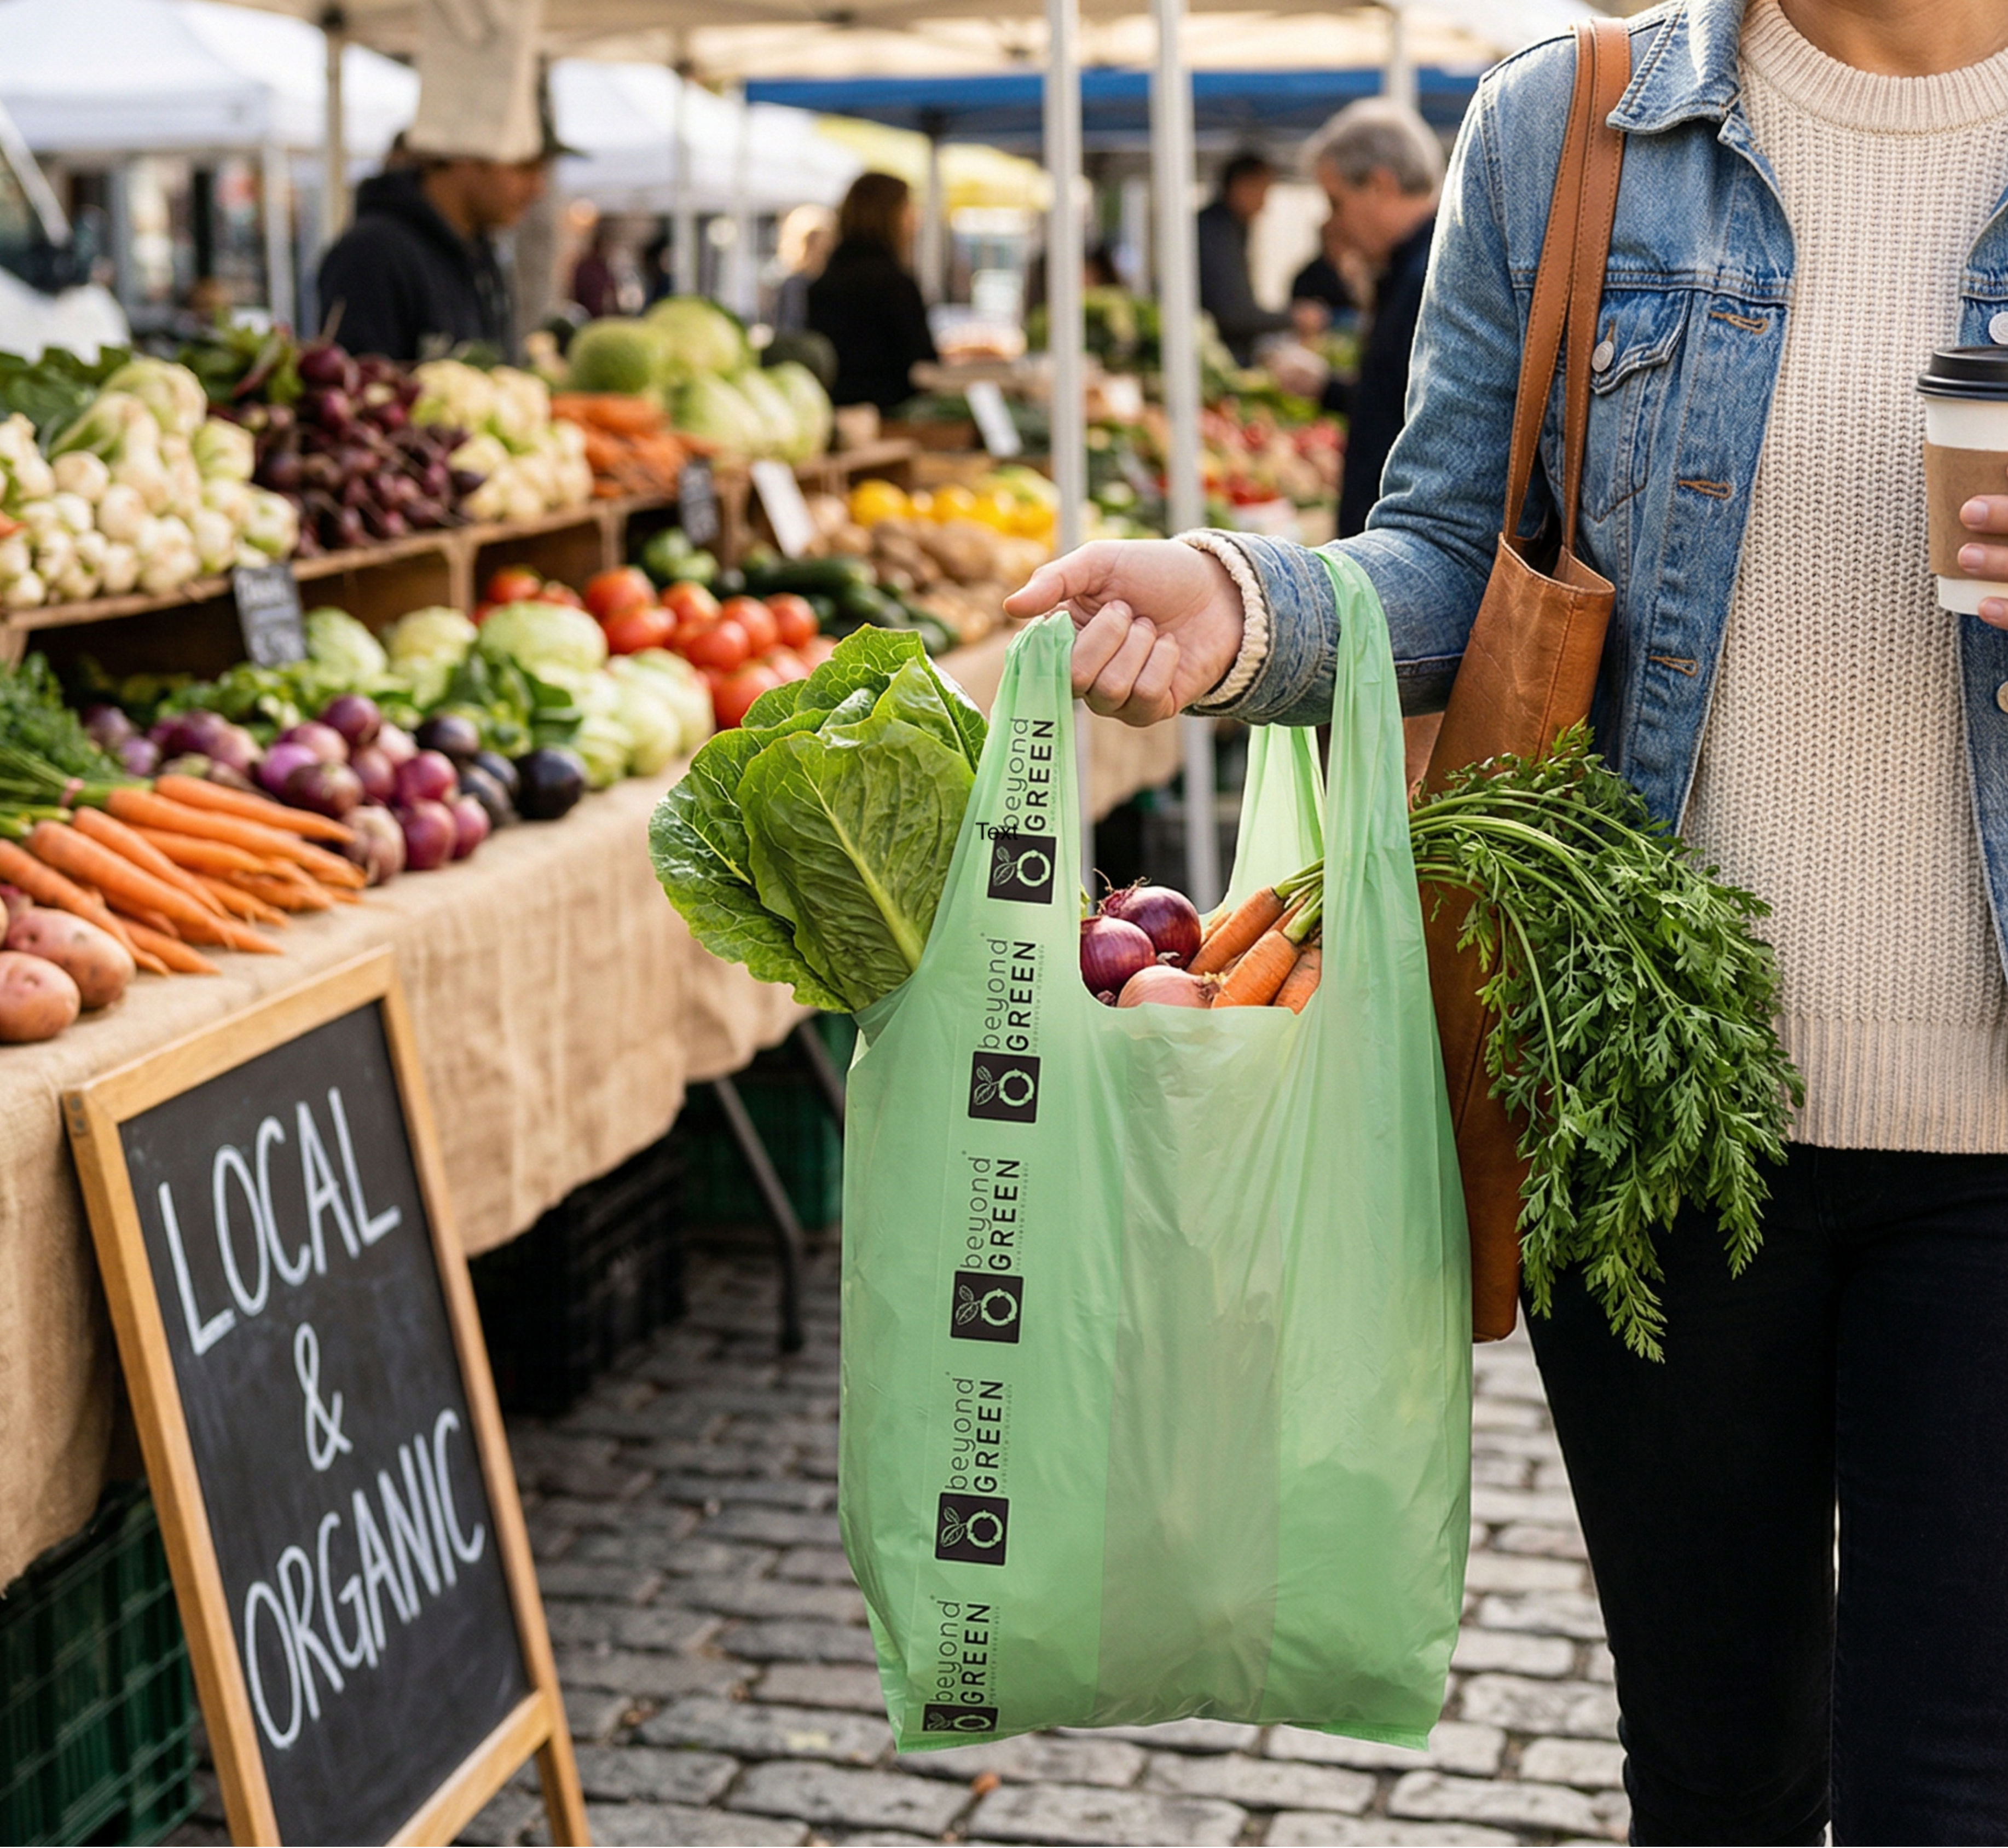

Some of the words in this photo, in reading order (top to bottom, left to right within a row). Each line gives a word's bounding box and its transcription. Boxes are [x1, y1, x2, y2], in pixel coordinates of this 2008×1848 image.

[998, 718, 1029, 829] beyond
[1024, 720, 1055, 831] GREEN
[977, 938, 1010, 1050] beyond
[1005, 941, 1037, 1052] GREEN
[158, 1087, 402, 1356] LOCAL
[959, 1156, 992, 1269] beyond
[988, 1159, 1020, 1271] GREEN
[294, 1323, 352, 1471] &
[944, 1377, 976, 1491] beyond
[973, 1380, 1004, 1493] GREEN
[244, 1408, 485, 1750] ORGANIC
[929, 1600, 963, 1702] beyond
[959, 1603, 991, 1705] GREEN
